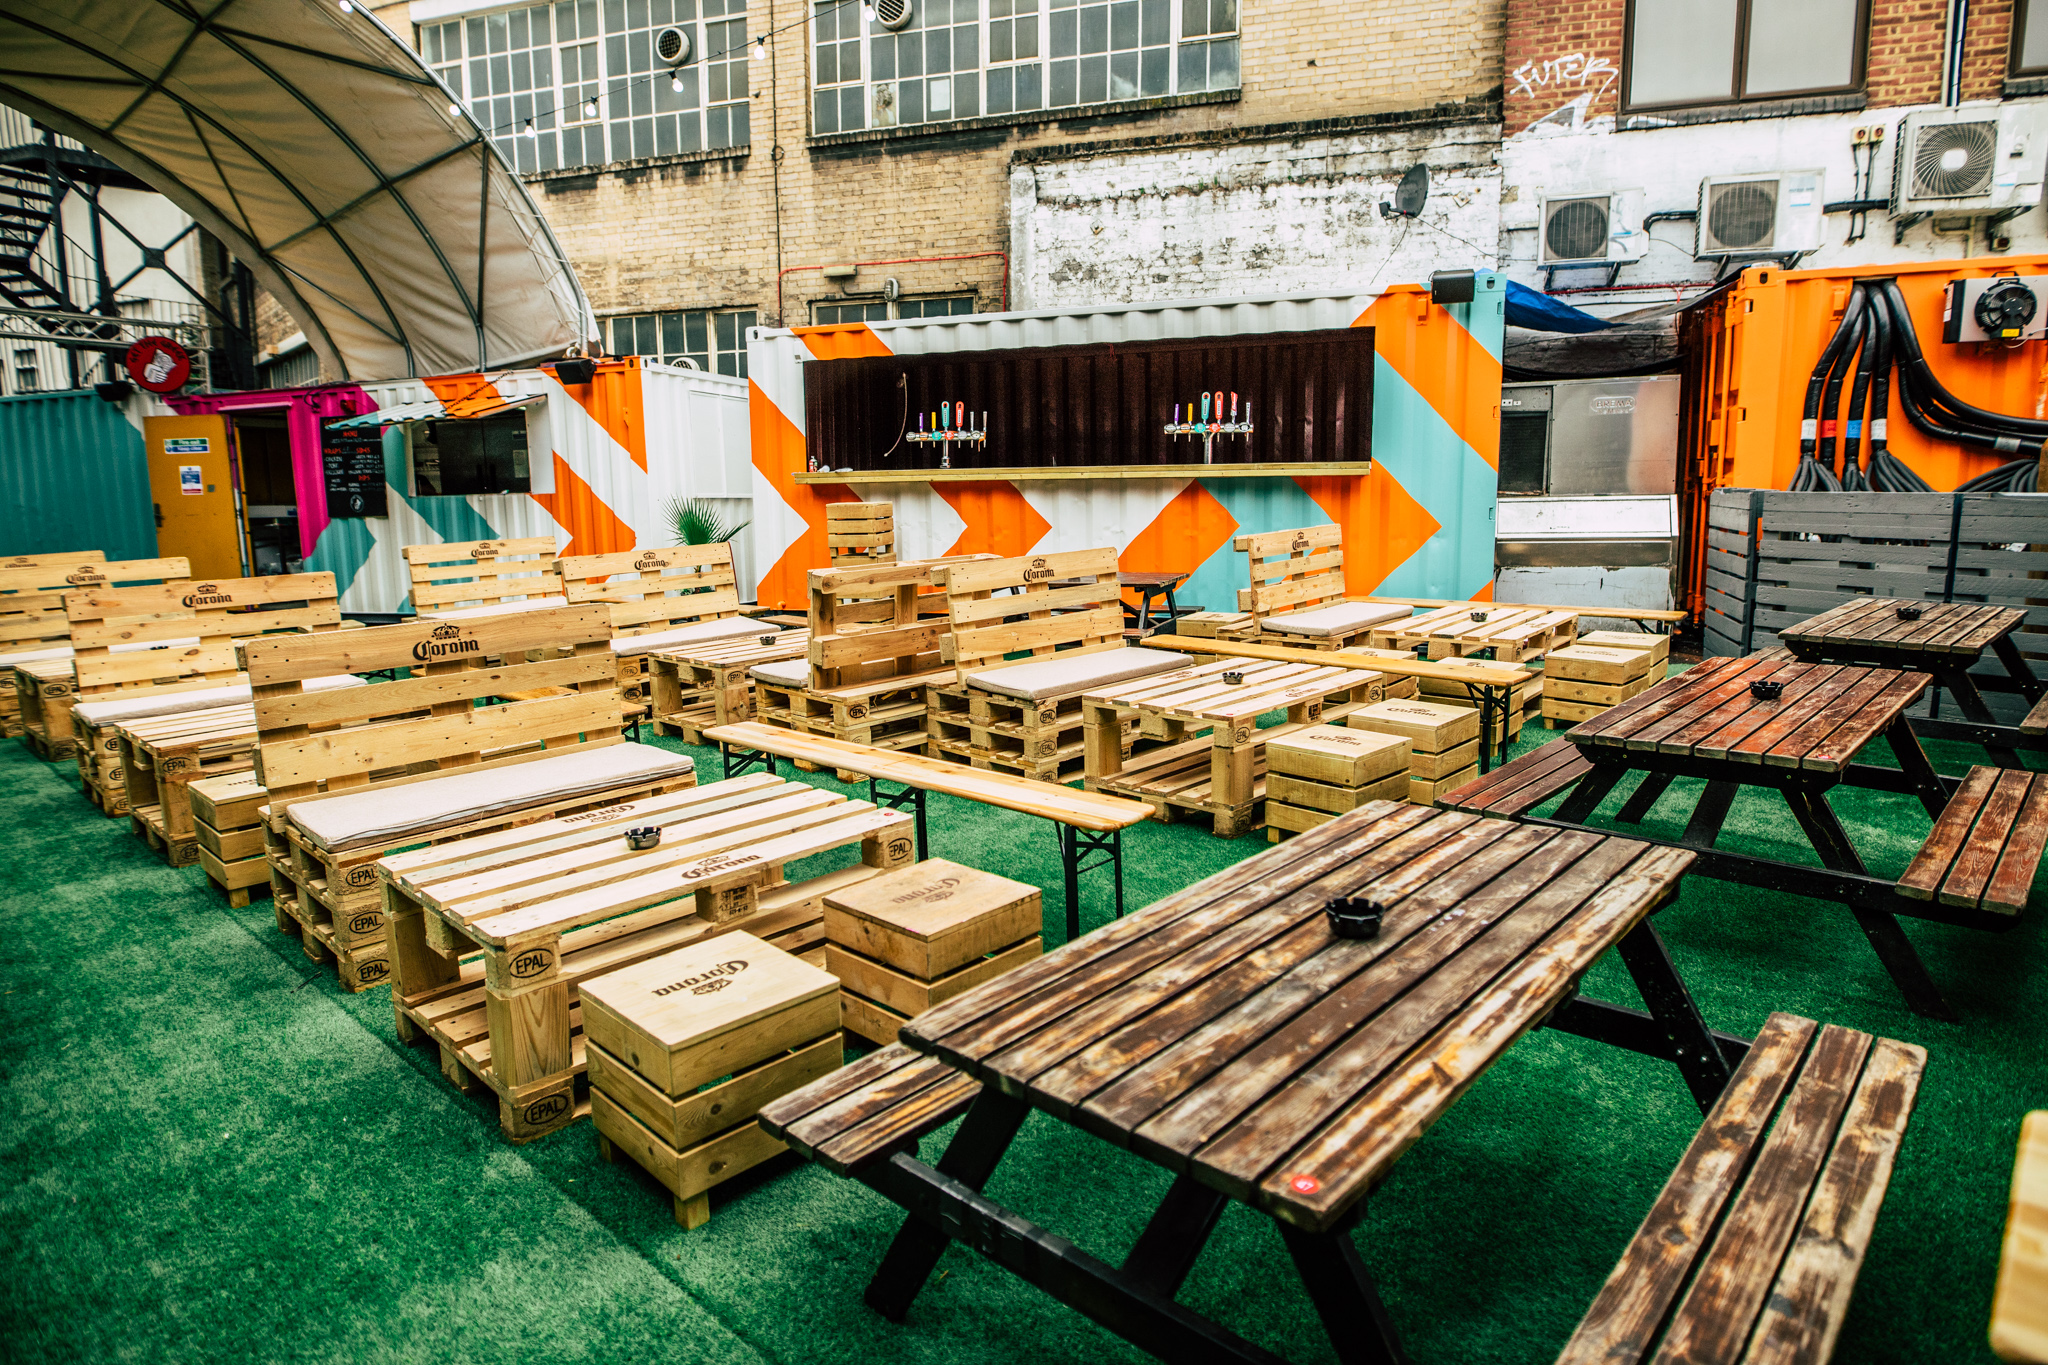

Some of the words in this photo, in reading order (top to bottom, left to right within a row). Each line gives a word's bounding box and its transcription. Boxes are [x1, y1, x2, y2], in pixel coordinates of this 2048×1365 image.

[471, 549, 499, 558] Corona
[634, 559, 666, 571] Corona
[66, 573, 107, 584] Corona
[1023, 568, 1056, 583] Corona
[182, 594, 233, 608] Corona
[412, 639, 480, 662] Corona
[561, 804, 636, 823] Corona
[888, 841, 909, 857] EPAL
[682, 854, 763, 878] Corona
[351, 867, 379, 884] EPAL
[889, 878, 961, 904] Corona
[354, 915, 382, 931] EPAL
[360, 963, 388, 980] EPAL
[515, 952, 549, 975] EPAL
[651, 960, 749, 996] Corona
[530, 1099, 563, 1122] EPAL
